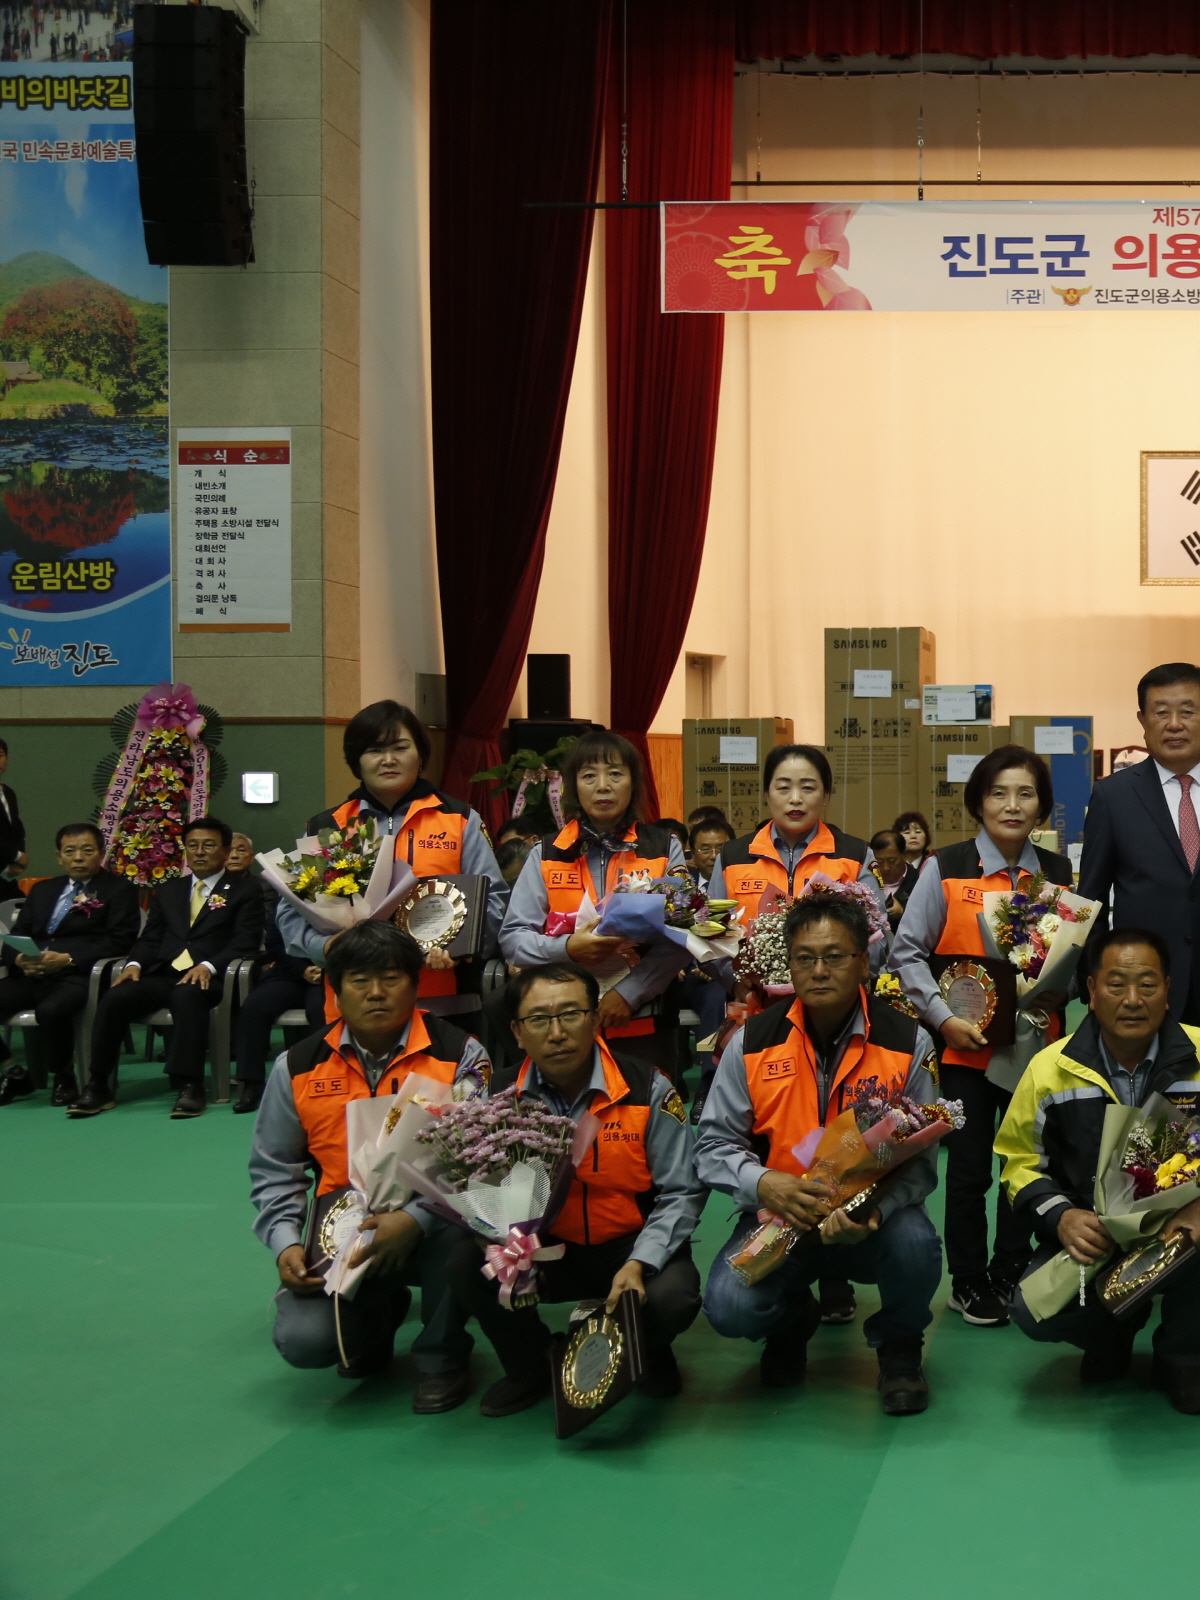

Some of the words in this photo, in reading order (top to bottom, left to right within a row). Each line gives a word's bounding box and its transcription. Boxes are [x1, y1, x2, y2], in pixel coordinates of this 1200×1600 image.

[0, 76, 131, 110] 비의바닷길
[22, 141, 136, 161] 민속문화예술특
[714, 226, 791, 295] 축
[940, 234, 1090, 278] 진도군
[1010, 289, 1042, 305] 주관
[195, 482, 227, 491] 내빈소개
[194, 494, 227, 503] 국민의례
[195, 507, 219, 516] 유공자
[221, 507, 237, 516] 표창
[194, 519, 219, 528] 주택용
[221, 519, 253, 528] 소방시설
[255, 519, 279, 528] 전달식
[195, 532, 219, 541] 장학금
[221, 532, 245, 541] 전달식
[195, 544, 227, 553] 대회선언
[10, 560, 116, 591] 운림산방
[195, 594, 219, 603] 결의문
[221, 594, 237, 603] 낭독
[833, 639, 888, 649] SAMSUNG
[13, 645, 61, 669] 보배섬
[62, 641, 119, 676] 진도
[694, 726, 742, 735] SAMSUNG
[930, 733, 979, 743] SAMSUNG
[696, 765, 728, 773] WASHING
[730, 765, 760, 773] MACHINE
[101, 730, 146, 852] 전라남도의용소방연
[418, 839, 458, 851] 의용소방대
